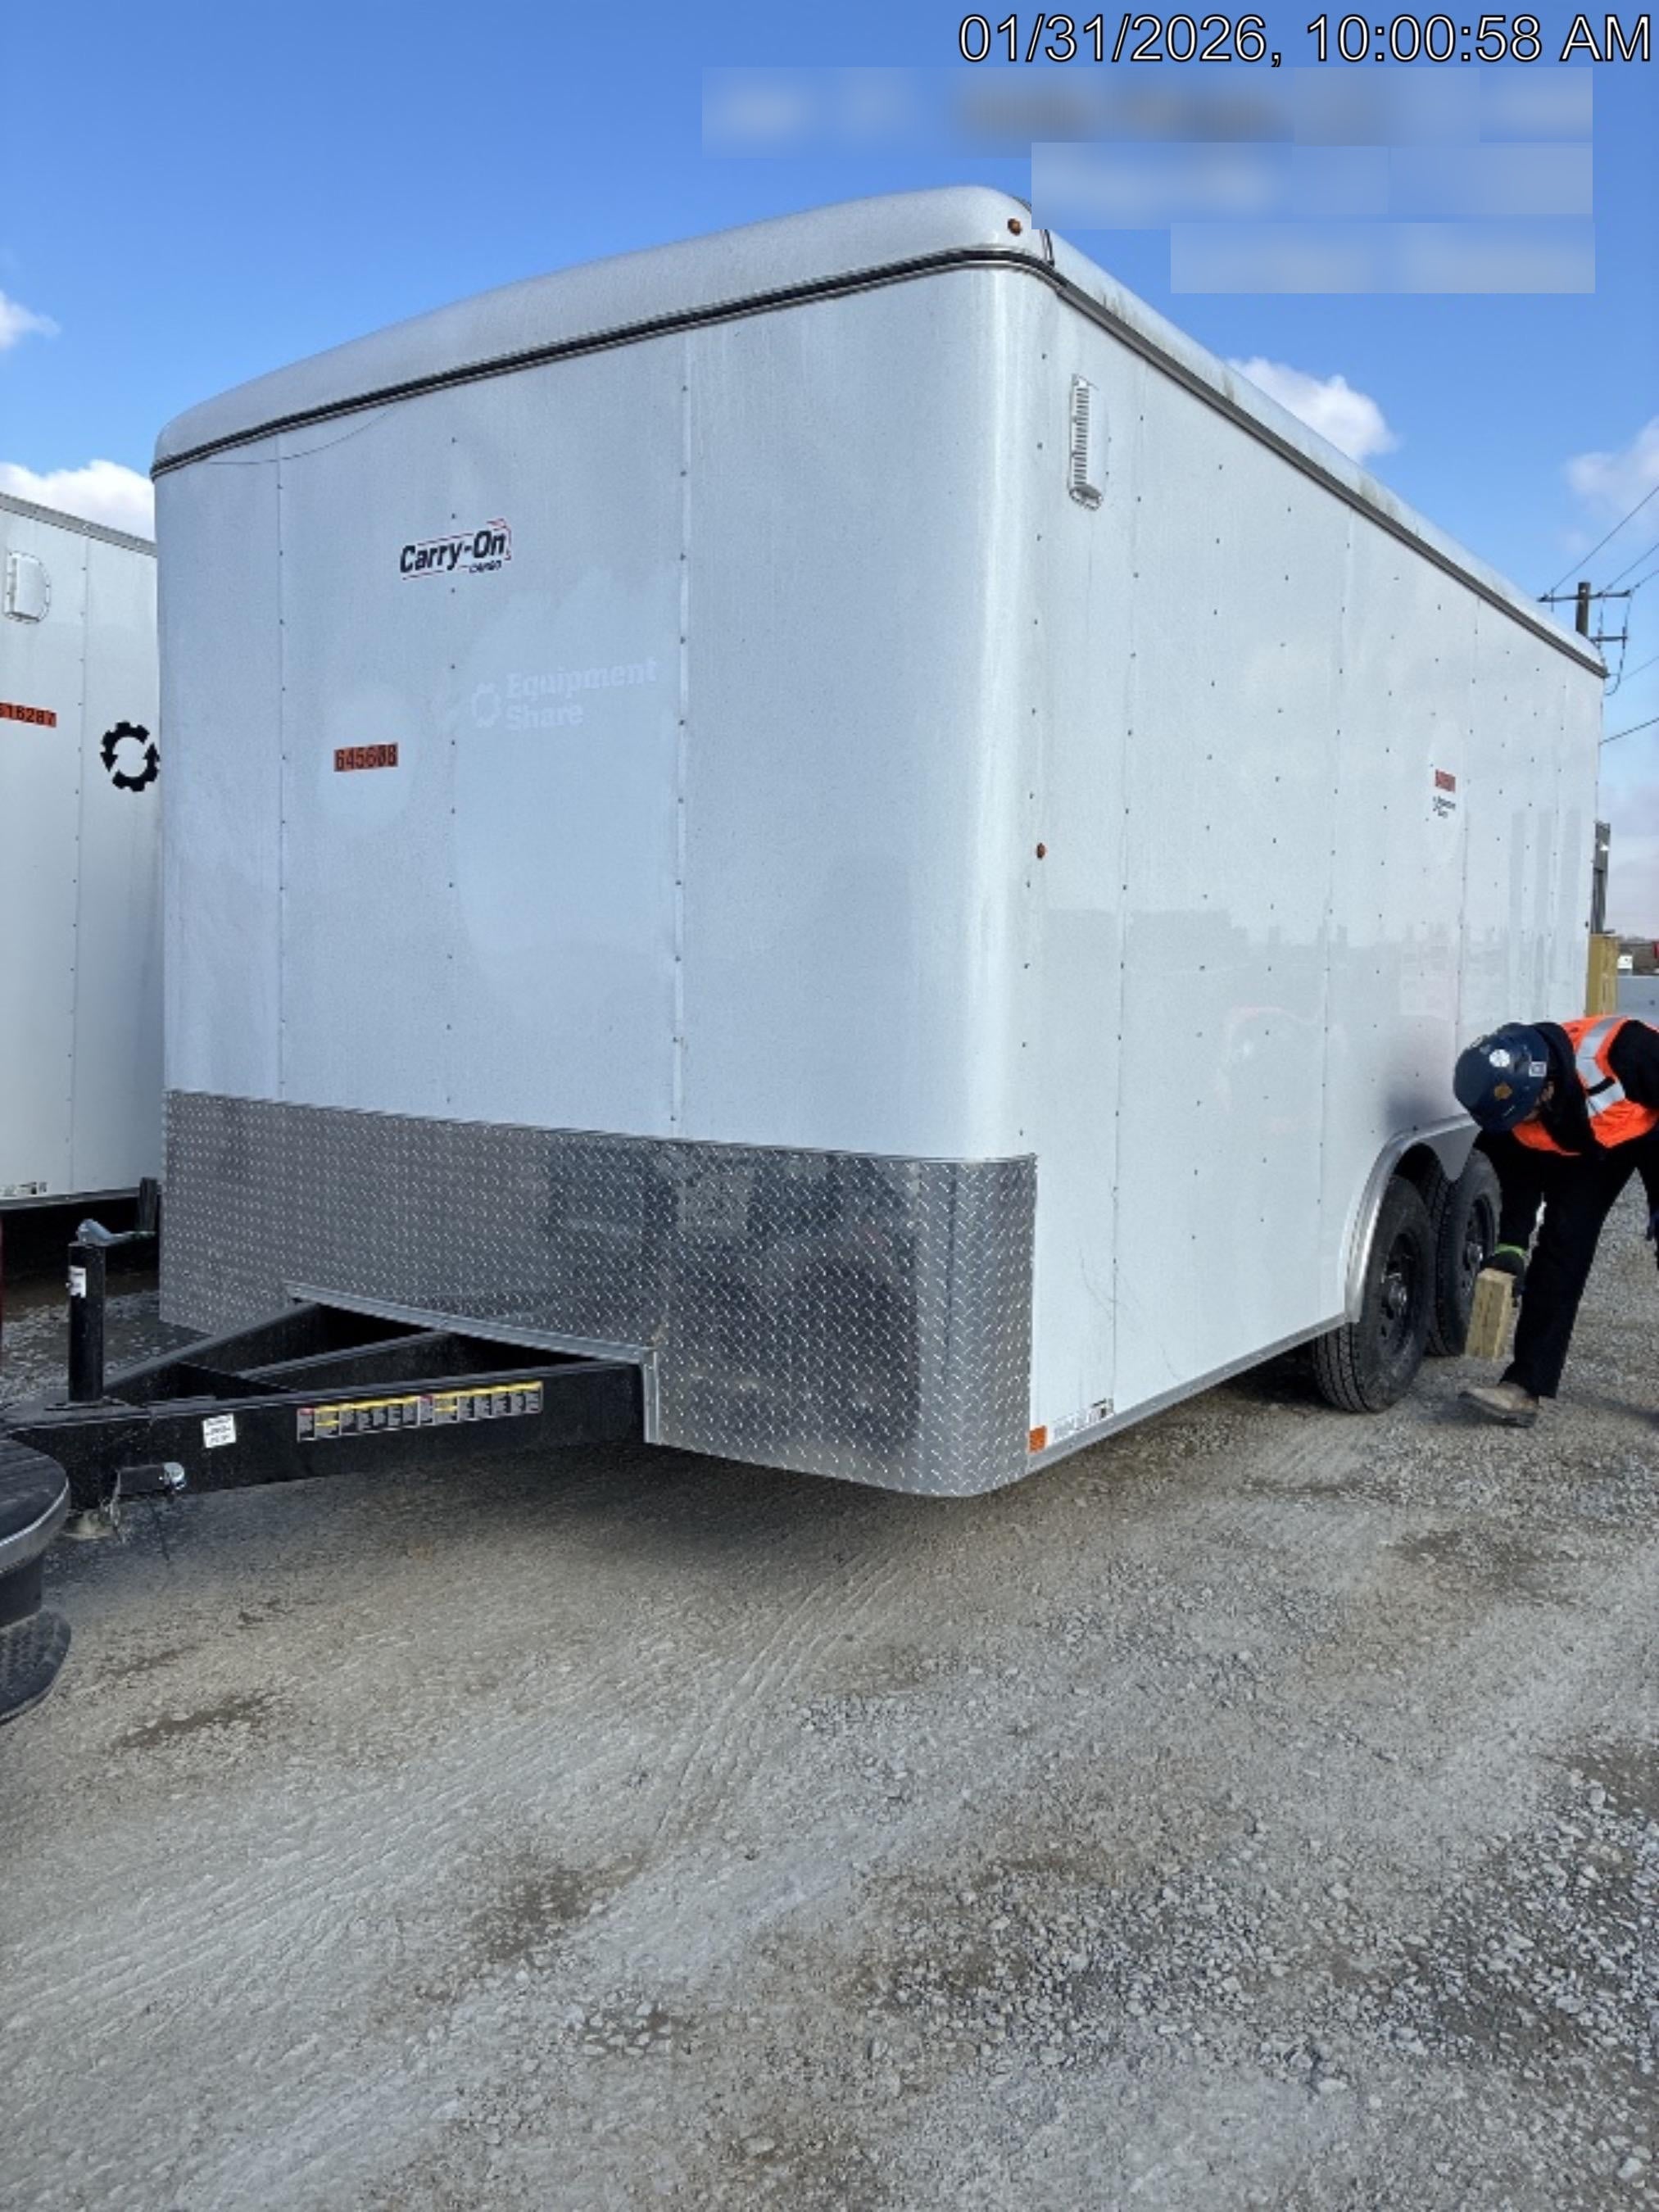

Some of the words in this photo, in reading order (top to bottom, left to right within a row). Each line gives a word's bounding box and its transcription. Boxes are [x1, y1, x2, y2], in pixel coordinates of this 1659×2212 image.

[400, 529, 507, 573] Carry-On
[505, 656, 657, 702] Equipment
[505, 705, 584, 731] Share
